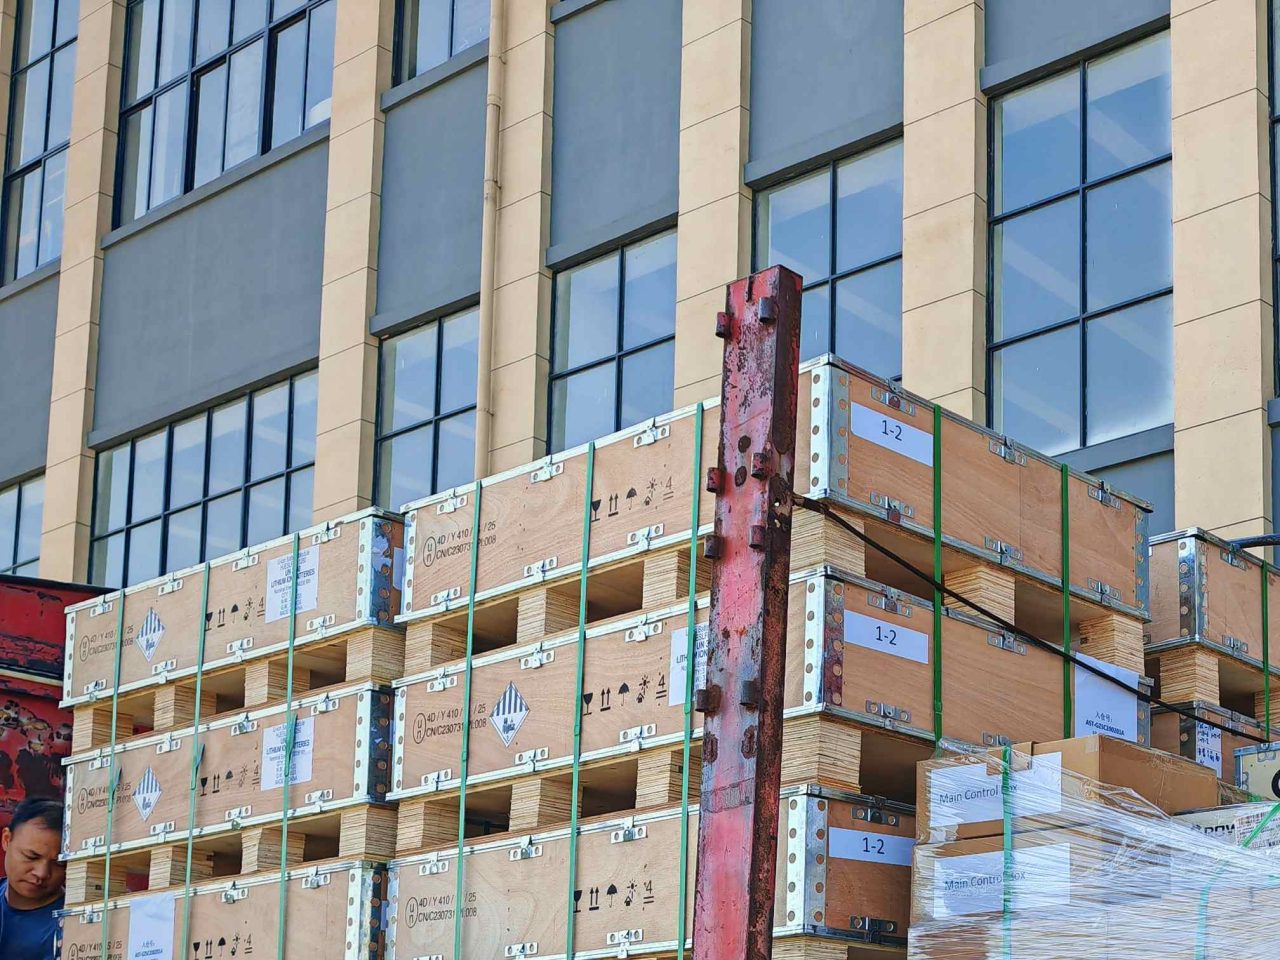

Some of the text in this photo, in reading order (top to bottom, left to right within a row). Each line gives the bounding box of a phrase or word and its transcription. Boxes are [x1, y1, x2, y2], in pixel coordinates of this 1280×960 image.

[882, 420, 903, 441] 1-2
[876, 626, 897, 646] 1-2
[939, 792, 963, 804] Main
[965, 784, 999, 800] Control
[863, 836, 886, 855] 1-2
[944, 878, 968, 891] Main
